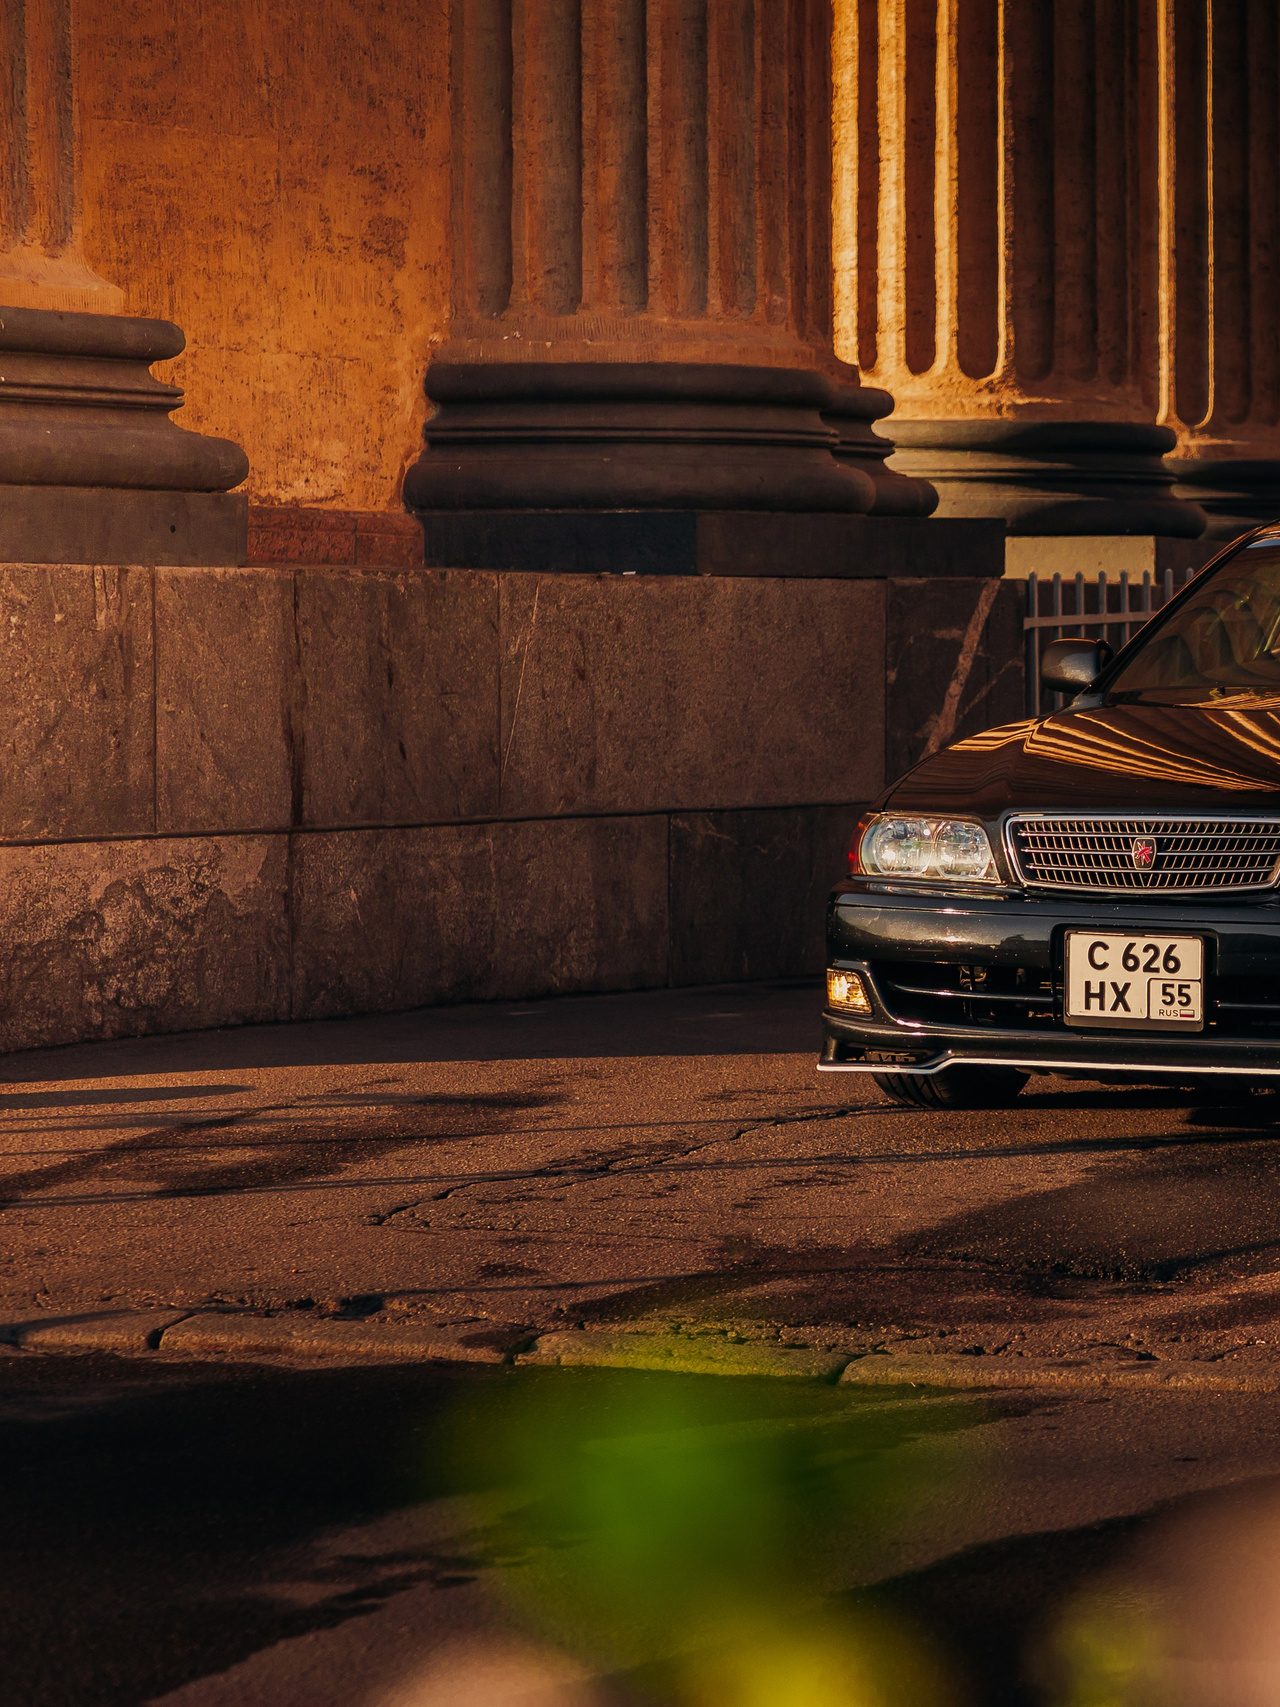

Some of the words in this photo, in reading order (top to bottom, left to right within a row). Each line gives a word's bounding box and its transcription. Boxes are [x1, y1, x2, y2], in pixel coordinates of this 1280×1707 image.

[1087, 940, 1110, 971] C
[1121, 942, 1182, 975] 626
[1084, 980, 1132, 1013] HX
[1161, 983, 1192, 1007] 55
[1158, 1009, 1179, 1017] RUS
